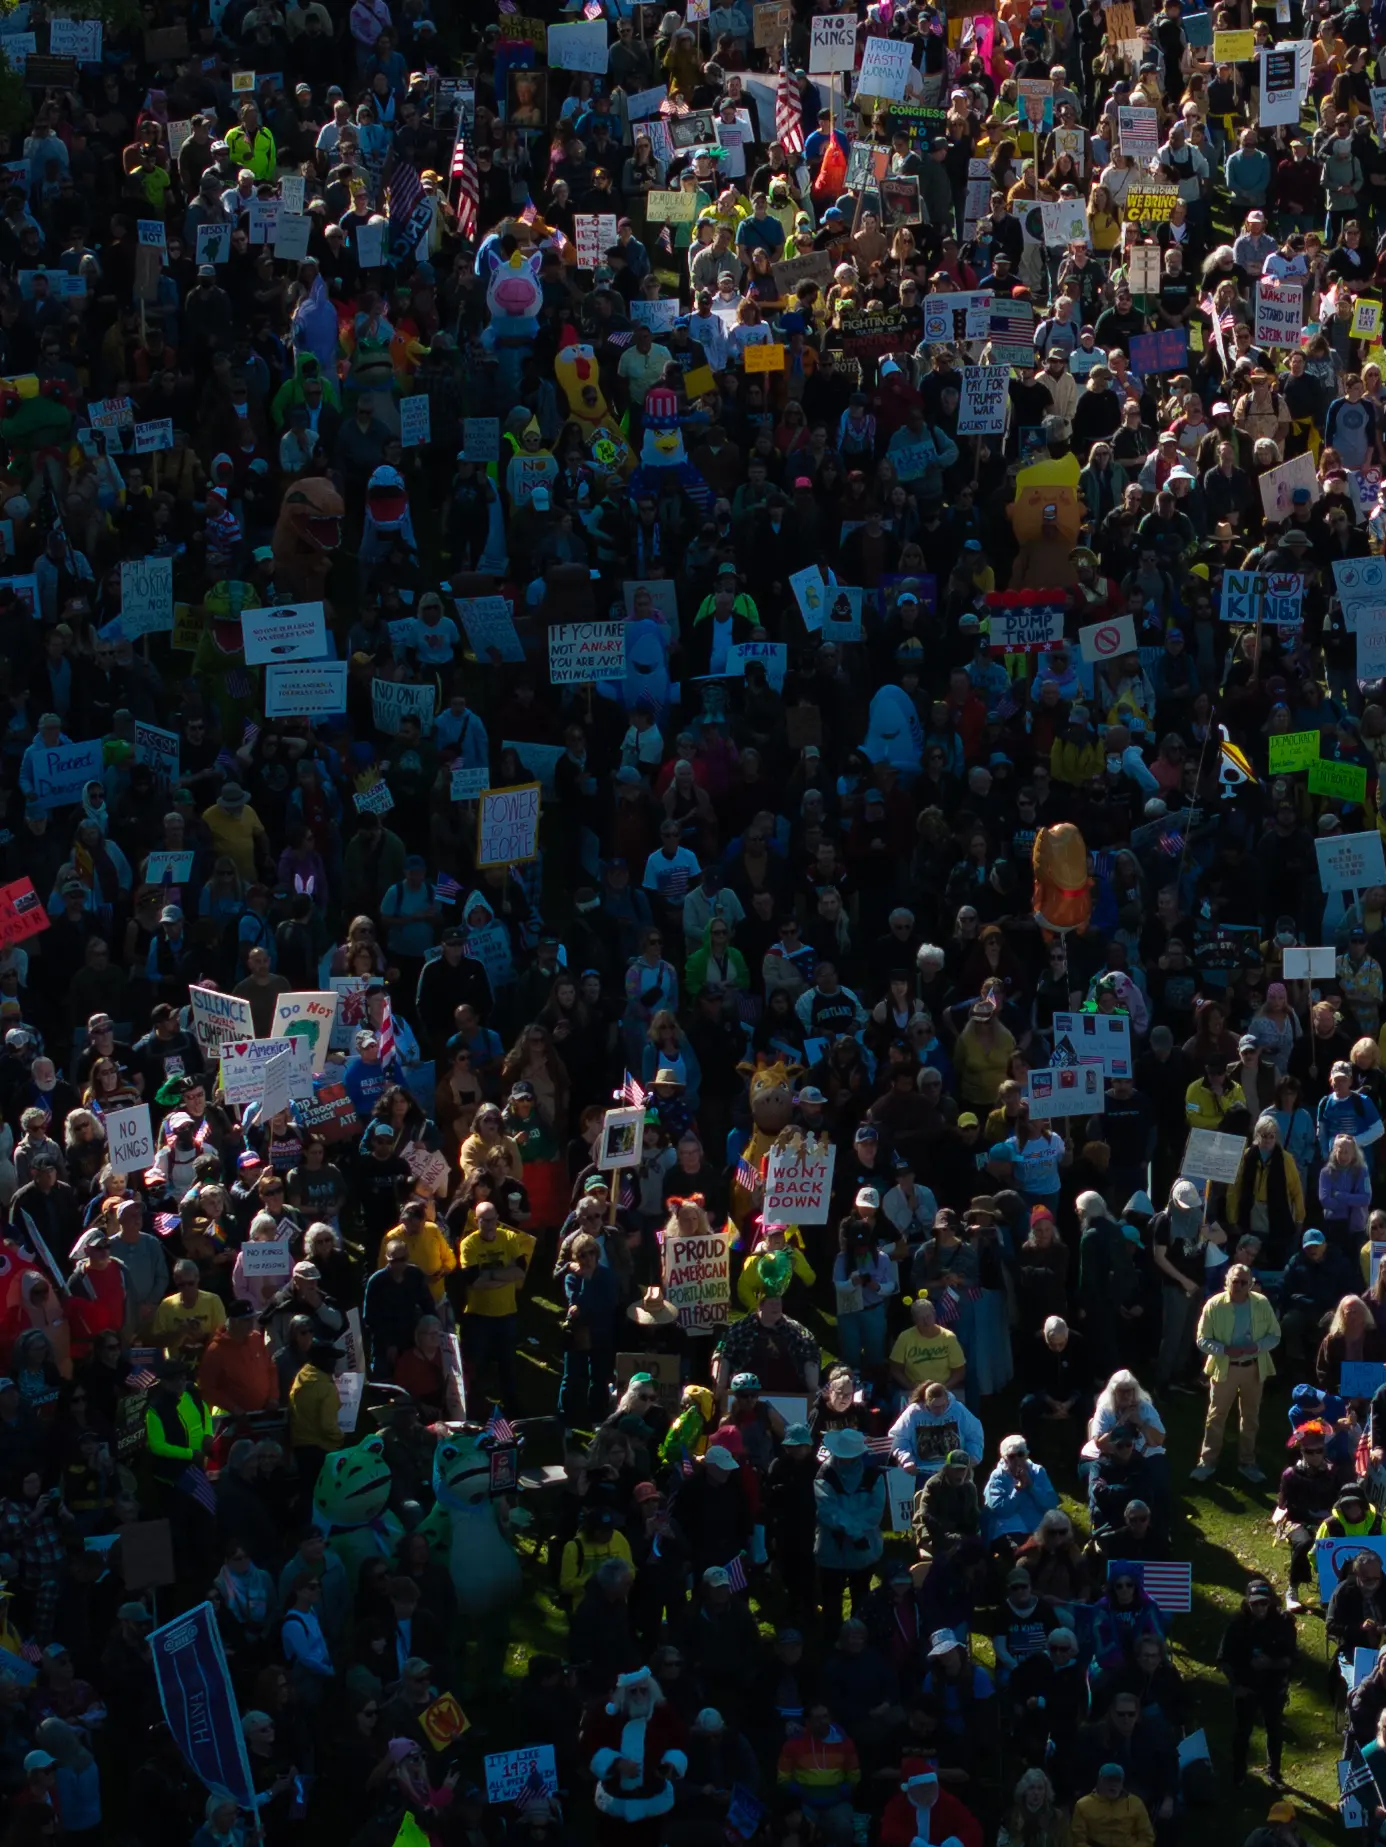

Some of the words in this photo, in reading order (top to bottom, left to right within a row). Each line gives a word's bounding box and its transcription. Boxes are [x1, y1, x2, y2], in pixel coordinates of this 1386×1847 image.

[823, 18, 845, 29] NO
[814, 30, 854, 46] KINGS
[870, 40, 907, 53] PROUD
[866, 53, 904, 66] NASTY
[862, 65, 904, 79] WOMAN
[890, 104, 946, 119] CONGRESS
[1127, 194, 1142, 207] WE
[1143, 194, 1177, 208] BRING
[1128, 208, 1170, 221] CARE
[143, 233, 162, 243] NOT
[1259, 289, 1285, 302] WAKE
[1287, 292, 1302, 305] UP!
[1258, 305, 1284, 322] STAND
[1285, 310, 1300, 324] UP!
[1360, 307, 1375, 316] LET
[842, 317, 895, 331] FIGHTING
[899, 314, 908, 325] A
[1285, 330, 1299, 344] UP!
[964, 369, 981, 380] OUR
[981, 367, 1008, 378] TAXES
[966, 380, 985, 391] PAY
[987, 378, 1004, 390] FOR
[967, 391, 1002, 406] TRUMPS
[973, 406, 995, 416] WAR
[991, 419, 1003, 430] US
[1227, 575, 1267, 595] NO
[1227, 595, 1300, 620] KINGS
[1006, 614, 1052, 630] DUMP
[551, 625, 567, 642] IF
[571, 625, 599, 637] YOU
[601, 623, 625, 637] ARE
[1001, 628, 1053, 645] TRUMP
[551, 644, 574, 656] NOT
[579, 641, 622, 653] ANGRY
[737, 643, 778, 658] SPEAK
[551, 657, 571, 668] YOU
[576, 656, 594, 667] ARE
[598, 654, 623, 666] NOT
[551, 669, 589, 682] PAYING
[374, 681, 393, 699] NO
[135, 729, 177, 755] FASCISM
[483, 790, 538, 823] POWER
[491, 824, 504, 837] TO
[508, 821, 528, 834] THE
[192, 991, 245, 1023] SILENCE
[817, 1005, 852, 1023] PORTLAND
[223, 1043, 234, 1060] I
[305, 1111, 336, 1127] POLICE
[340, 1112, 357, 1127] ATF
[120, 1121, 137, 1139] NO
[114, 1137, 150, 1164] KINGS
[773, 1165, 828, 1179] WON'T
[774, 1180, 823, 1194] BACK
[768, 1196, 822, 1208] DOWN
[247, 1249, 259, 1257] NO
[672, 1239, 726, 1265] PROUD
[668, 1260, 727, 1288] AMERICAN
[669, 1280, 730, 1306] PORTLANDER
[908, 1343, 949, 1358] Oregon
[1317, 1540, 1334, 1551] NO
[189, 1690, 211, 1744] FAITH
[516, 1749, 542, 1762] LIKE
